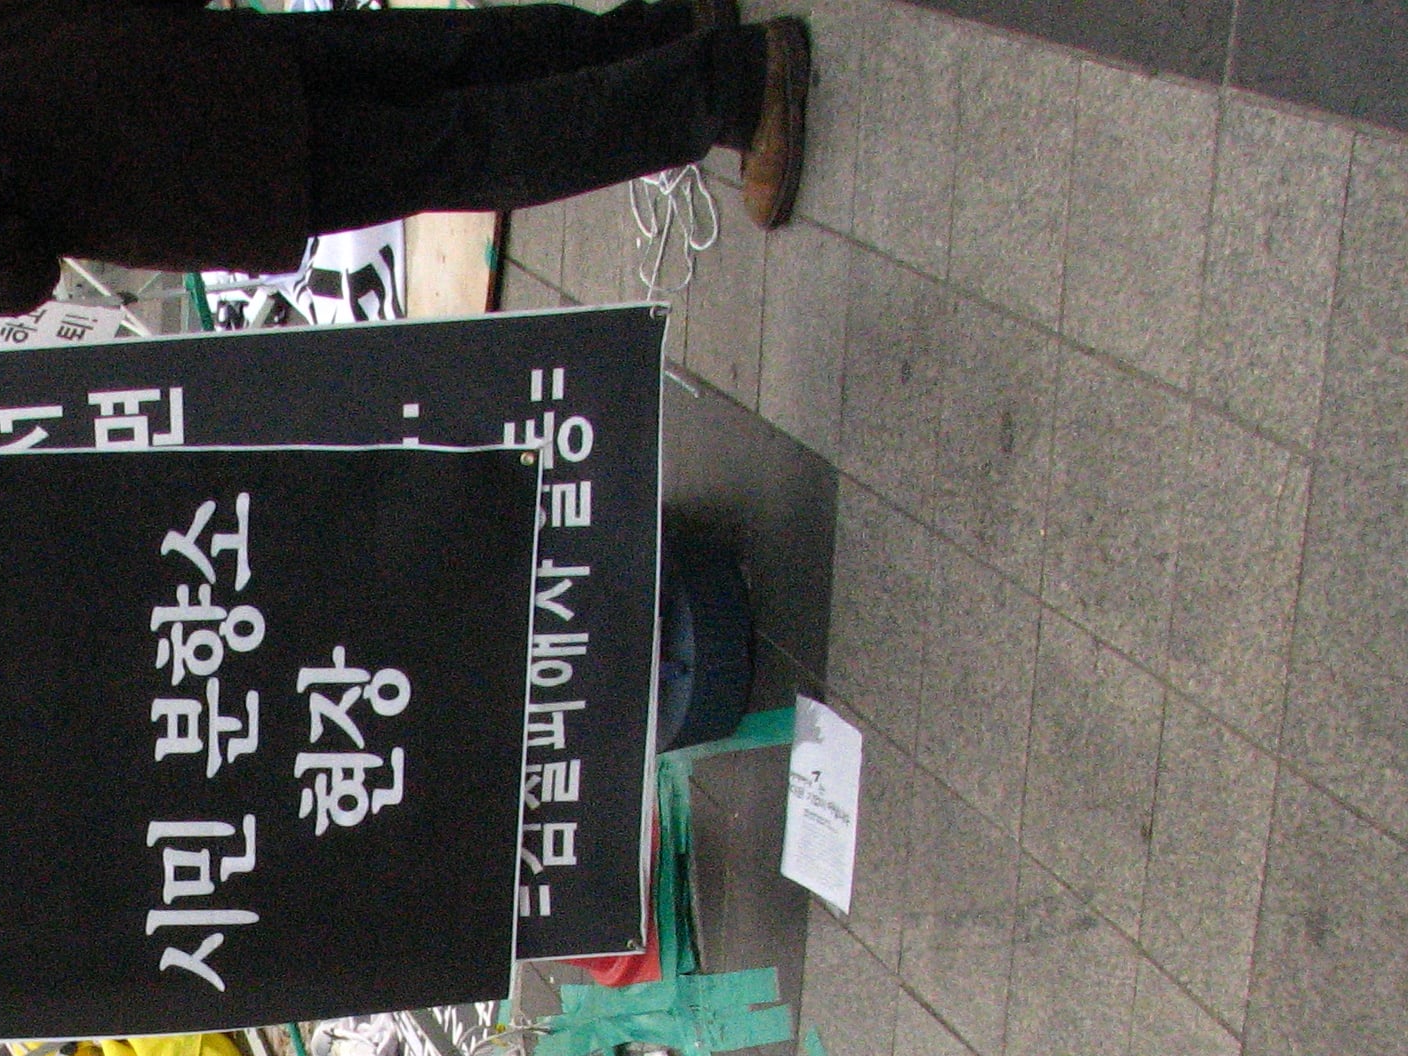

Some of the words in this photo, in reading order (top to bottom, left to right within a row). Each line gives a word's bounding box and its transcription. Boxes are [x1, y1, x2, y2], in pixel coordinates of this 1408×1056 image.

[86, 385, 184, 450] 면
[151, 493, 265, 777] 분향소
[295, 646, 410, 835] 현장
[146, 815, 258, 991] 시민
